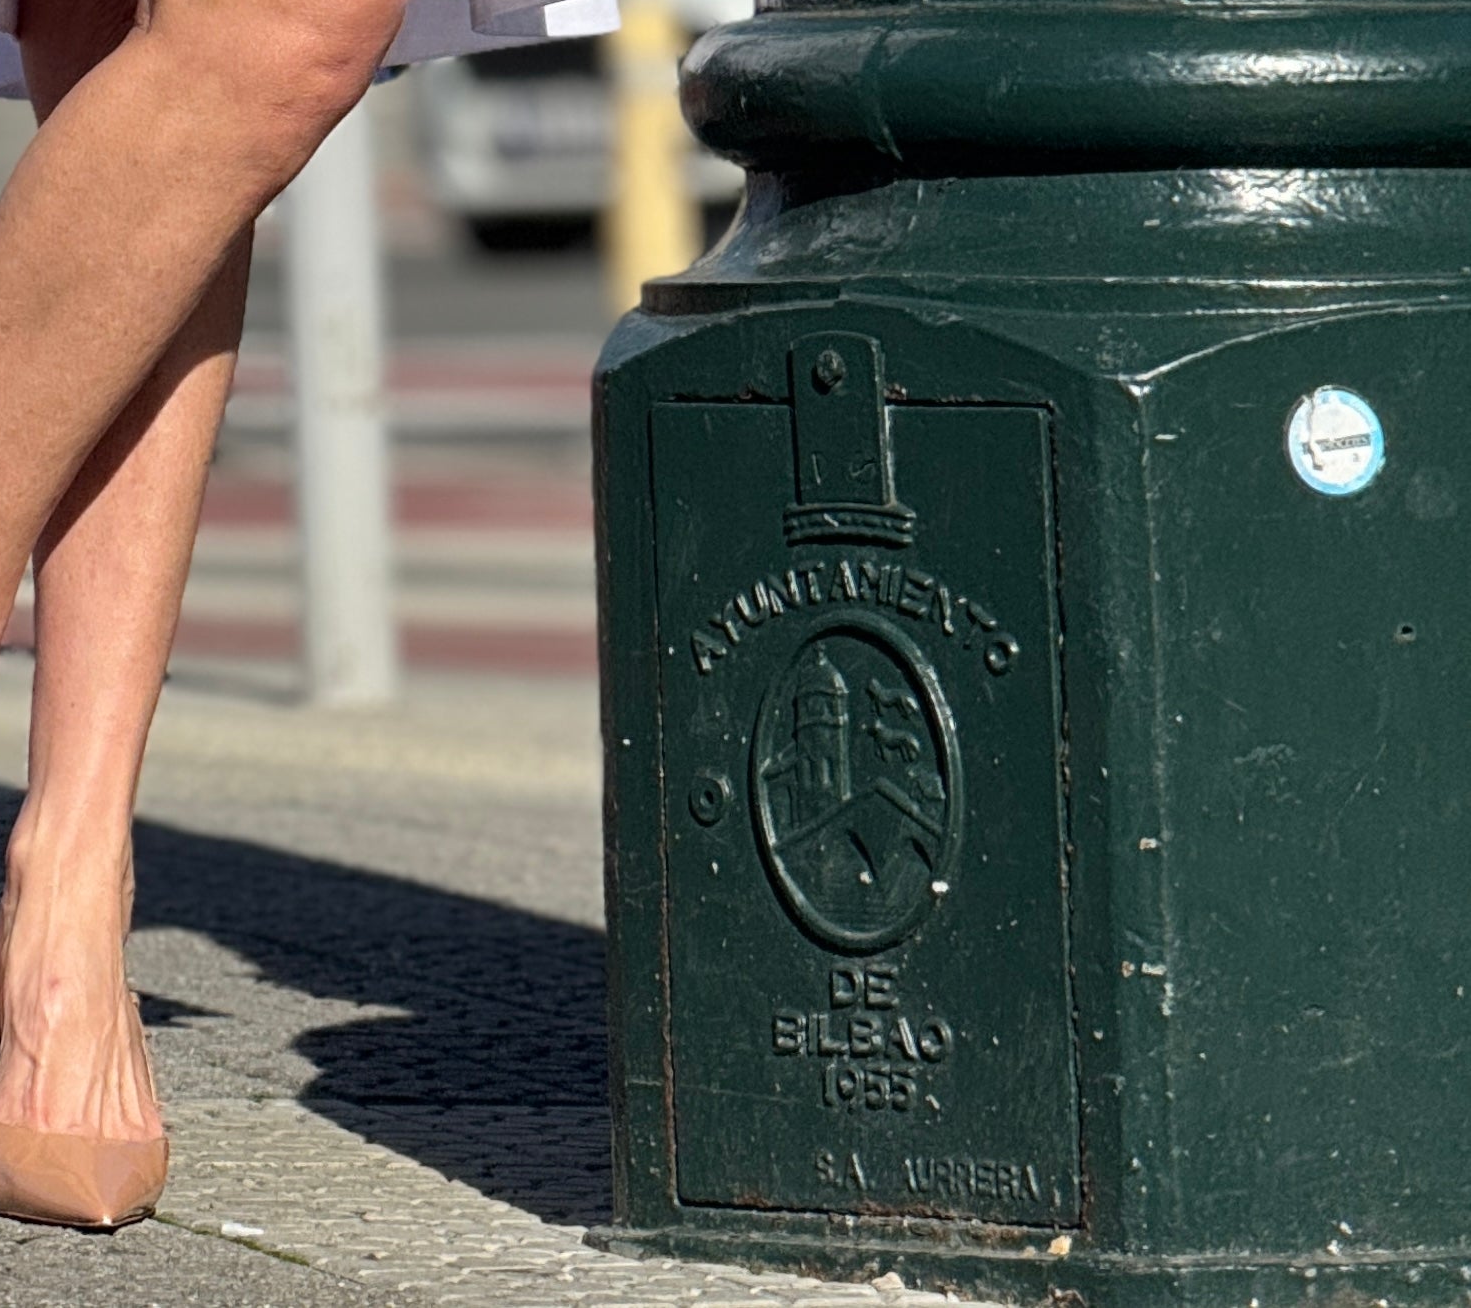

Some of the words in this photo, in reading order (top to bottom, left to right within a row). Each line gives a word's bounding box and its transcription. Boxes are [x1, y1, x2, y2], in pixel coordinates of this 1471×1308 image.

[690, 558, 1021, 676] AYUNTAMIENTO
[829, 962, 900, 1011] DE
[771, 1009, 955, 1064] BILBAO
[822, 1061, 918, 1113] 1955
